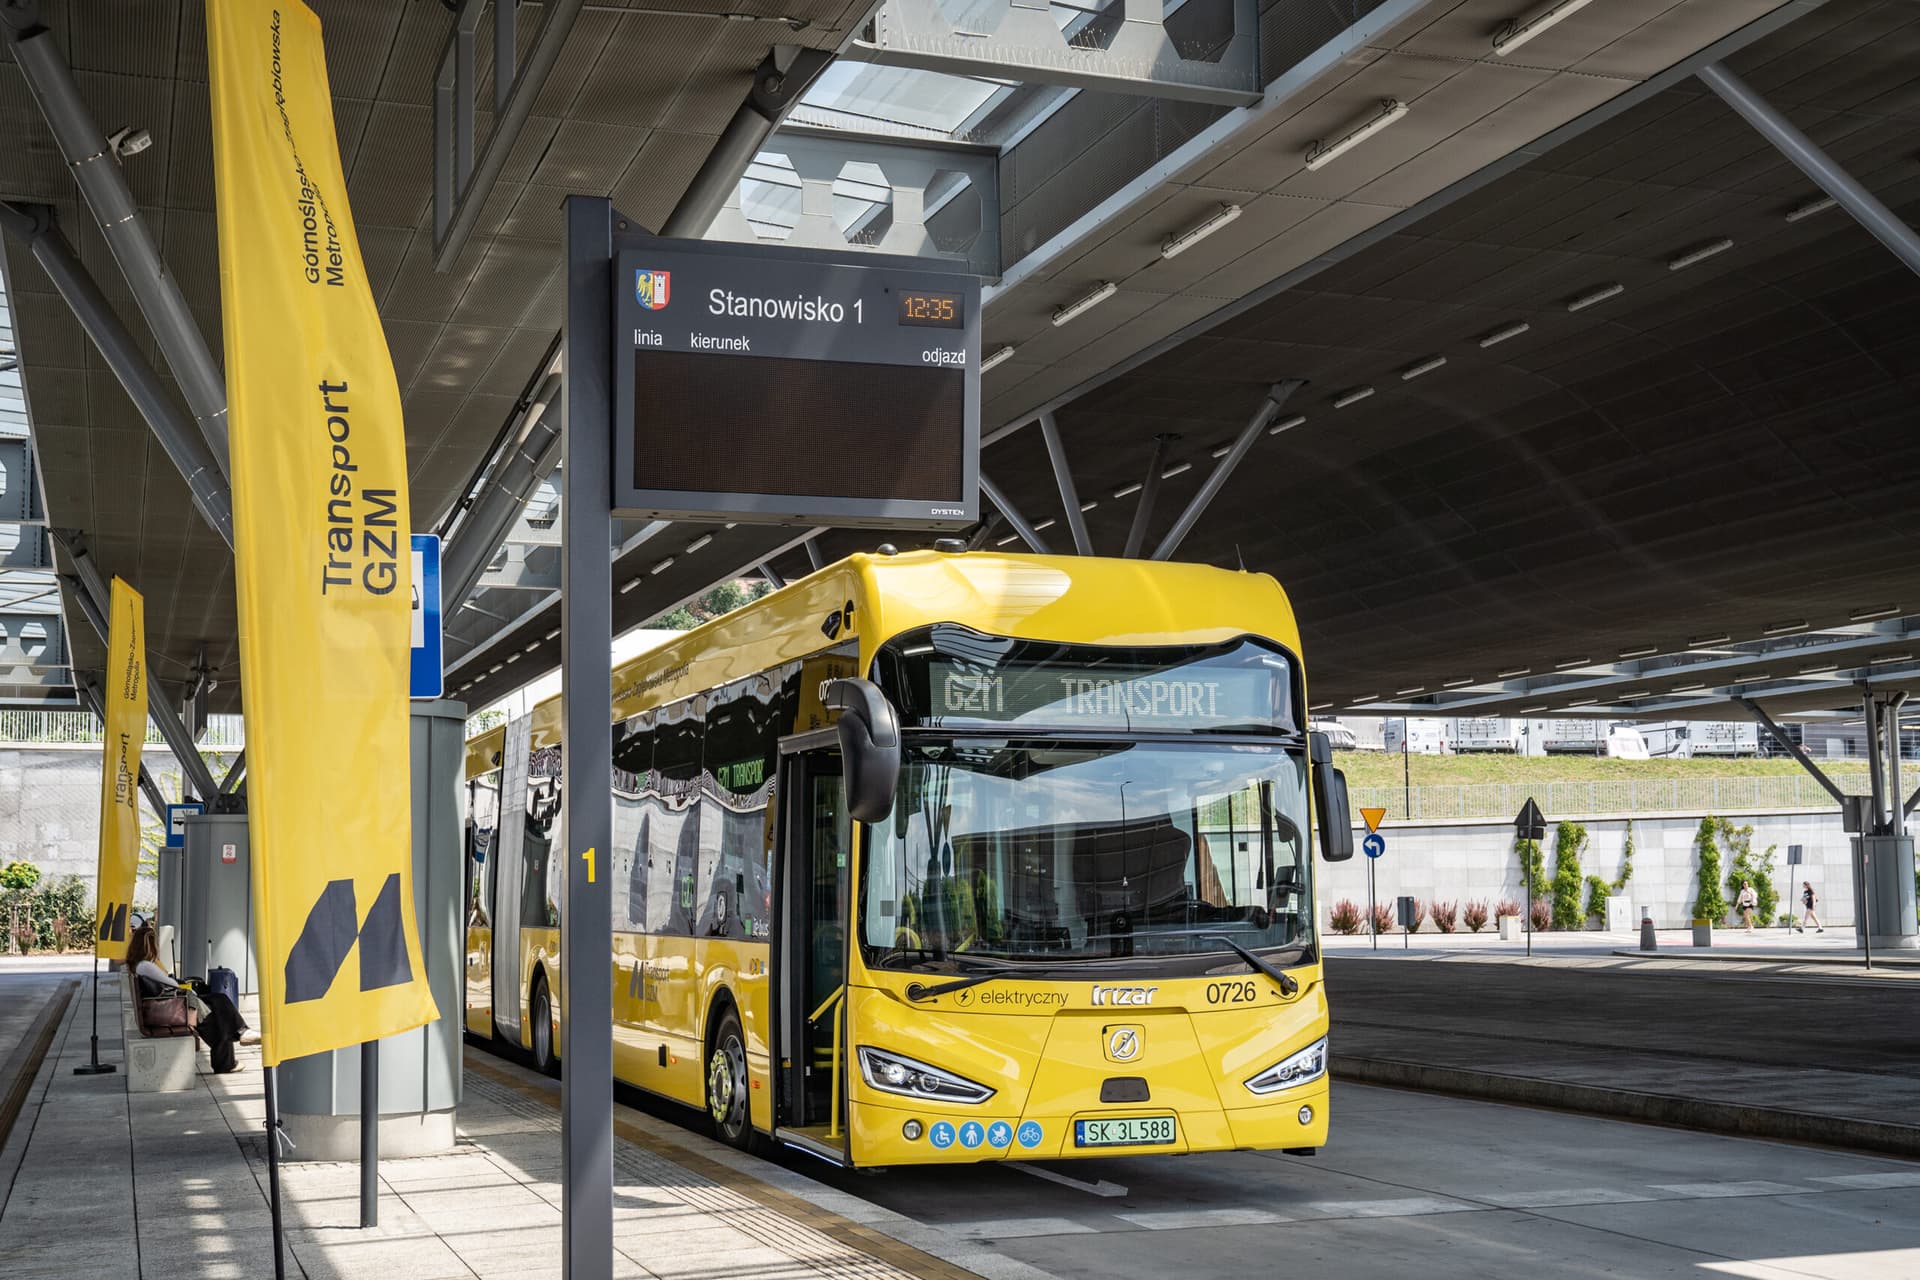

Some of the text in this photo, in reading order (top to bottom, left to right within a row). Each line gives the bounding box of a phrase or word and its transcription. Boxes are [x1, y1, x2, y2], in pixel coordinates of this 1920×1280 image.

[708, 288, 864, 324] Stanowisko 1
[903, 296, 955, 320] 12:35
[634, 329, 966, 367] linia kierunek odjazd
[318, 379, 358, 595] Transport
[930, 508, 965, 516] DYSTEN
[361, 488, 397, 596] GZM
[818, 677, 838, 702] 07
[943, 675, 1219, 718] GZM TRANSPORT
[582, 847, 596, 883] 1
[980, 989, 1069, 1007] elektryczny
[1206, 981, 1257, 1004] 0726
[1088, 1120, 1170, 1142] SK 3L588
